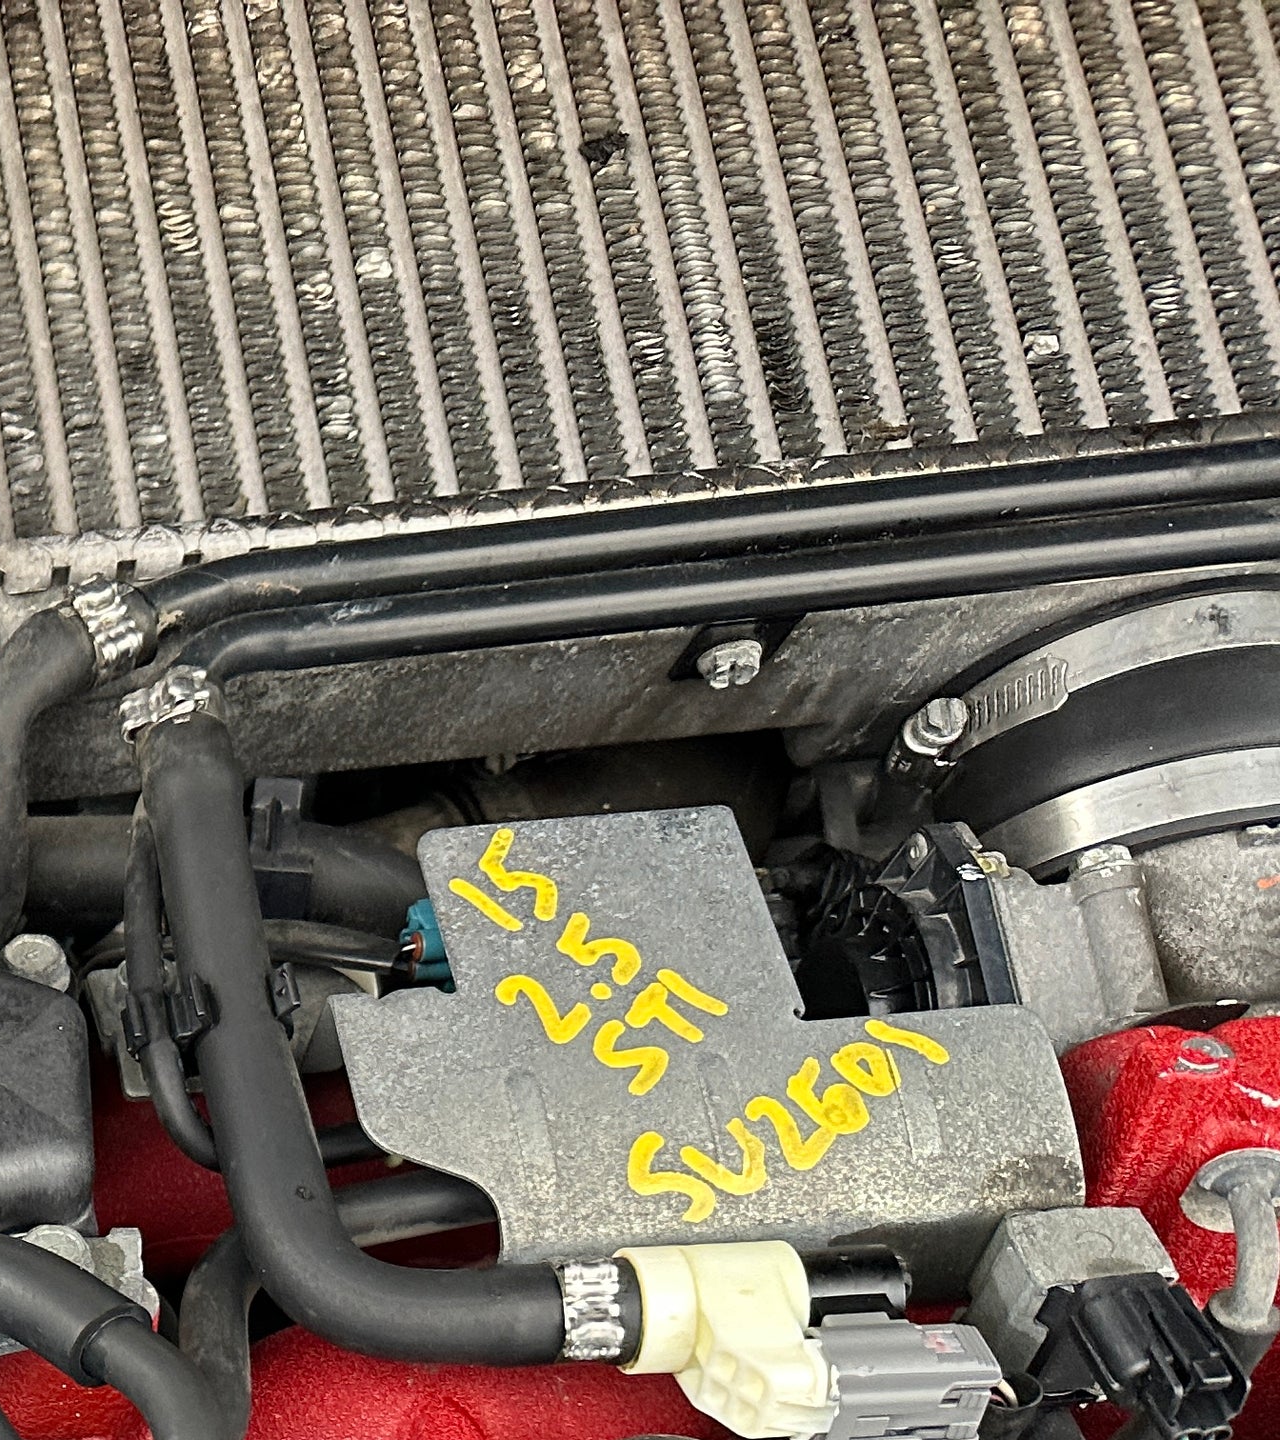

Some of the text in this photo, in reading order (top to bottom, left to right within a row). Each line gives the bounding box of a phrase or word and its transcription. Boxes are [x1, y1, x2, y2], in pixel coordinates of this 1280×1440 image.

[449, 828, 559, 932] 15
[494, 912, 642, 1044] 2.5
[592, 968, 729, 1096] STI
